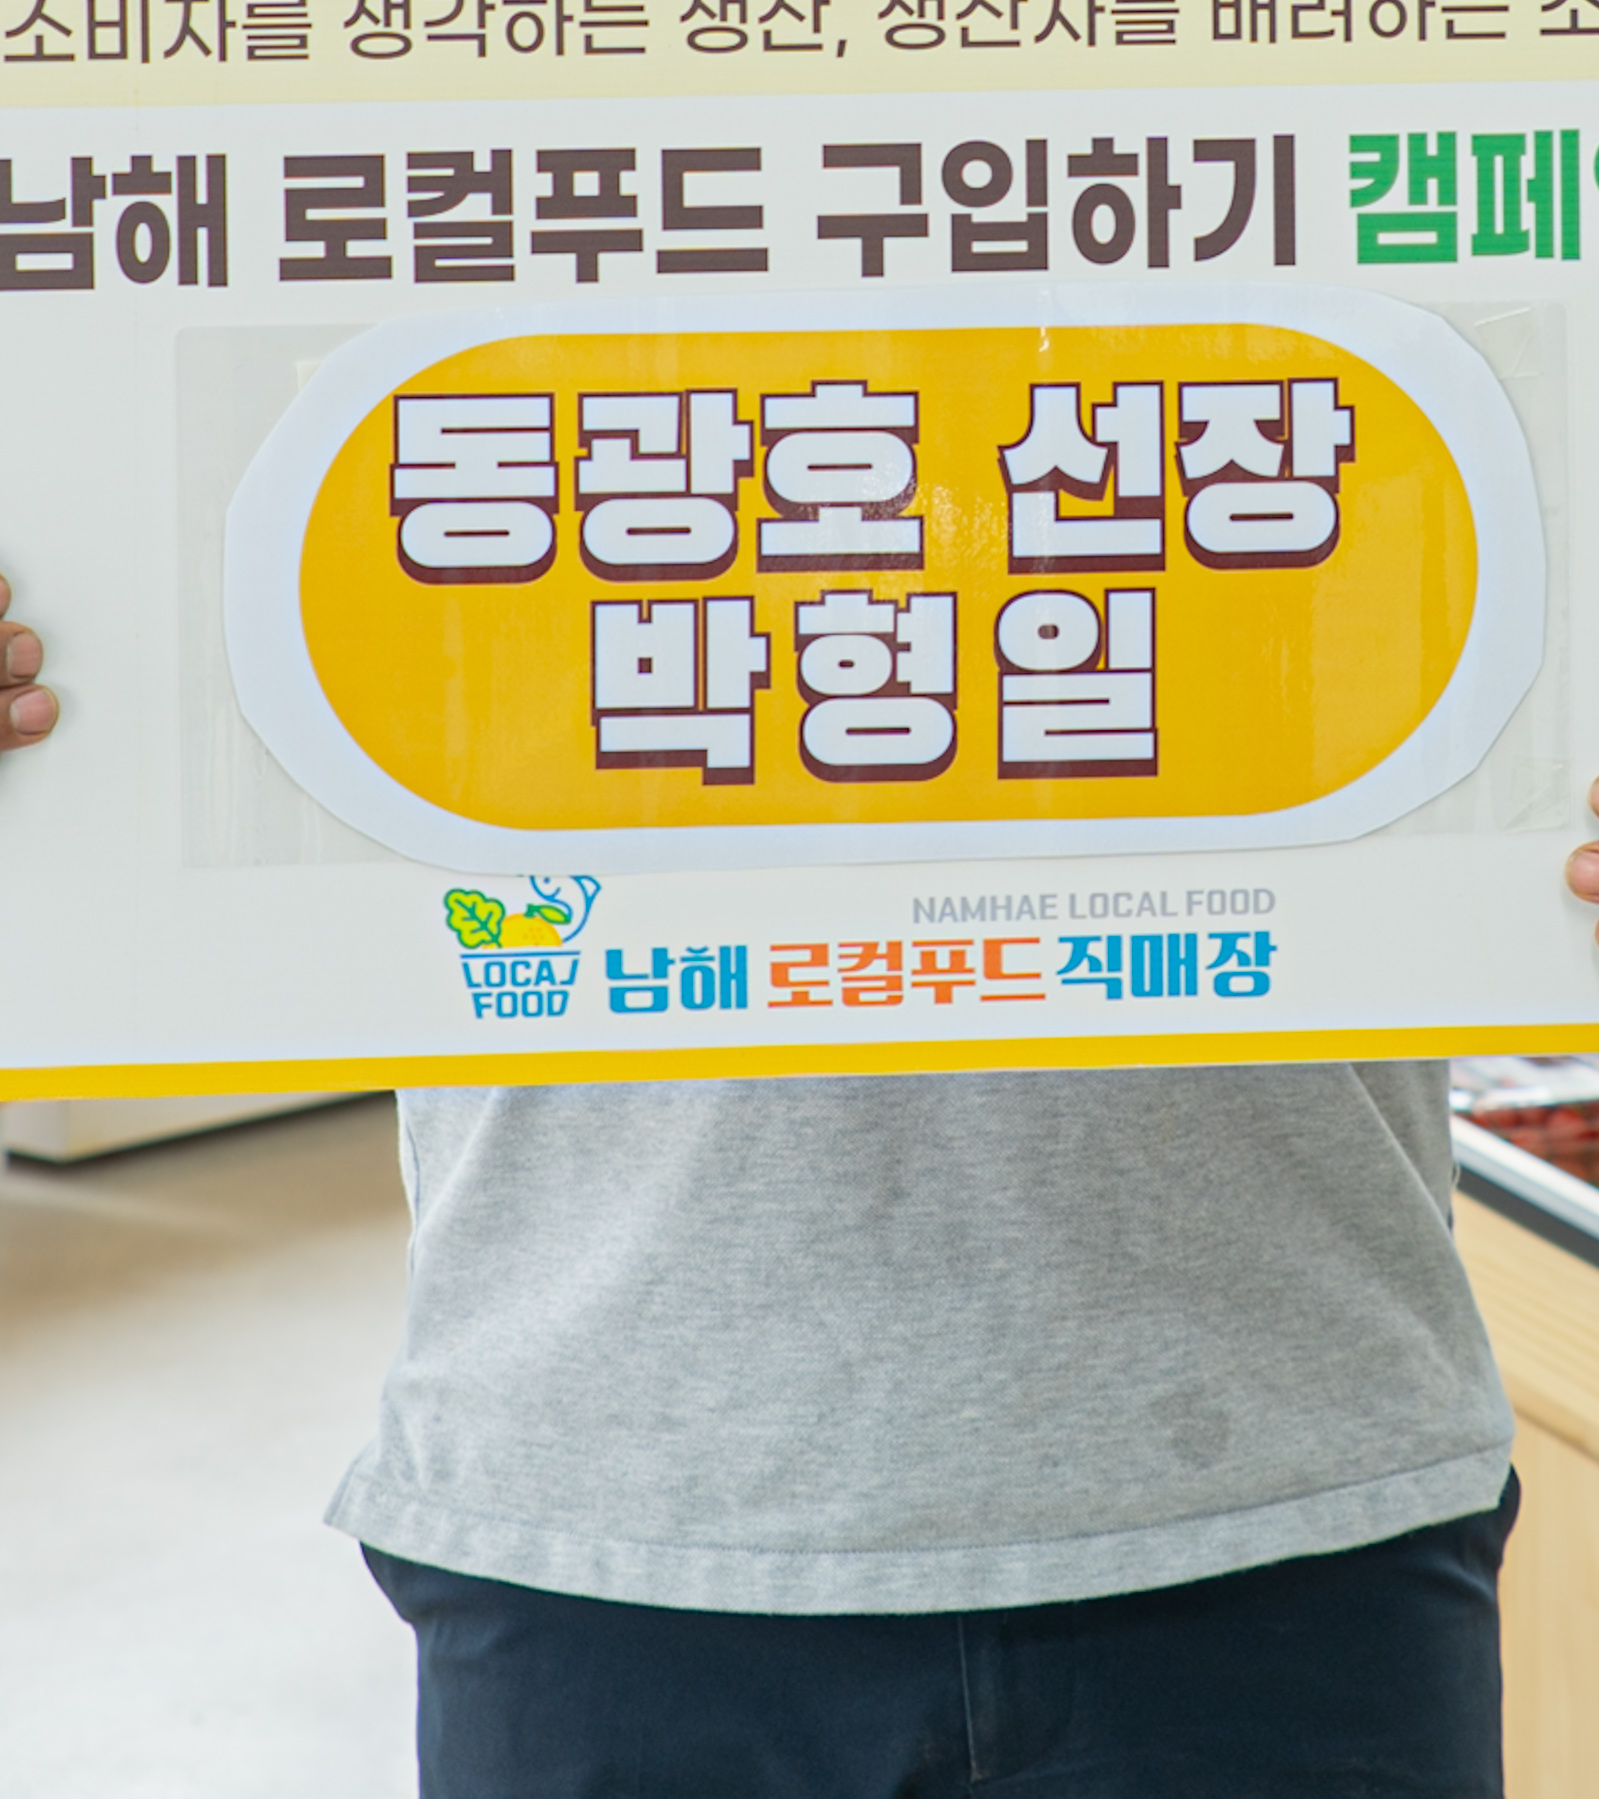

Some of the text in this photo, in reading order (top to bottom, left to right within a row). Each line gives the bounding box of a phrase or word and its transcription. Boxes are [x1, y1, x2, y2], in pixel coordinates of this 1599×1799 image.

[278, 147, 770, 284] 로컬푸드
[817, 134, 1296, 278] 구입하기
[390, 378, 1356, 584] 동광호 선장
[590, 587, 1159, 785] 박형일
[911, 887, 1278, 925] NAMHAE LOCAL FOOD
[472, 990, 569, 1019] FOOD
[604, 930, 1279, 1015] 남해 로컬푸드 직매장
